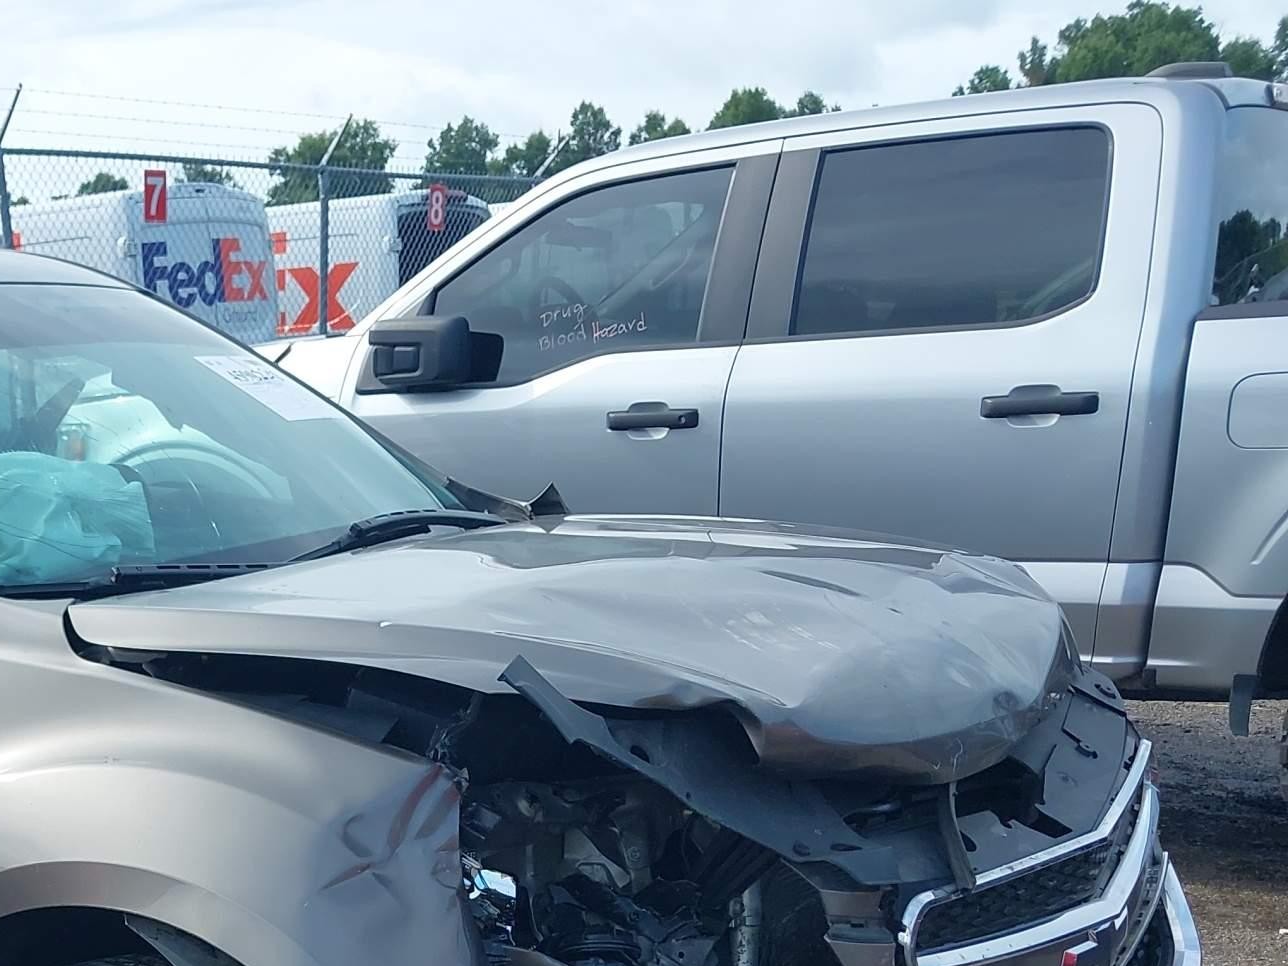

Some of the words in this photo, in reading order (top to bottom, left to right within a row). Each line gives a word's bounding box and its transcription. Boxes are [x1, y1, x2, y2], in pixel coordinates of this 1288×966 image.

[147, 177, 164, 216] 7
[431, 191, 443, 225] 8
[142, 236, 268, 308] FedEx
[538, 323, 587, 351] Blood
[592, 312, 648, 344] Hazard
[540, 303, 588, 330] Drug
